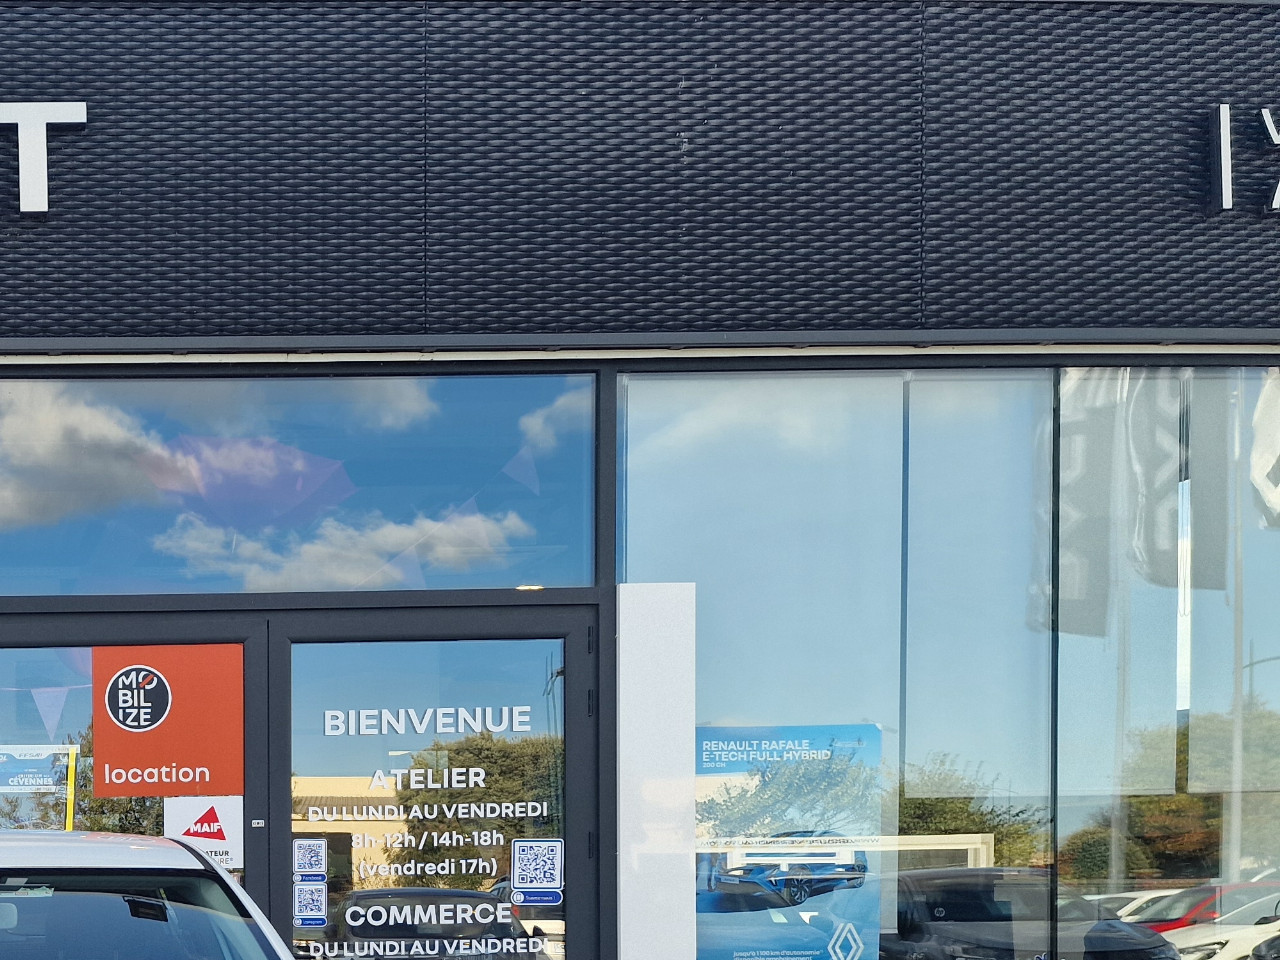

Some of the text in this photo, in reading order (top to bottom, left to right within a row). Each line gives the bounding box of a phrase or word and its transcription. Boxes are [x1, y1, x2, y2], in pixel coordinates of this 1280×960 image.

[324, 705, 531, 736] BIENVENUE
[702, 739, 810, 751] RENAULT RAFALE
[702, 750, 831, 762] E-TECH FULL HYBRID
[104, 762, 210, 784] location
[369, 767, 486, 790] ATELIER
[308, 802, 548, 822] DU LUNDI AU VENDREDI
[189, 822, 221, 833] MAIF
[351, 833, 416, 849] 8h-12h
[431, 830, 504, 847] 14h-18h
[359, 857, 498, 878] (vendredi 17h)
[344, 903, 513, 927] COMMERCE
[309, 938, 548, 957] DU LUNDI AU VENDREDI
